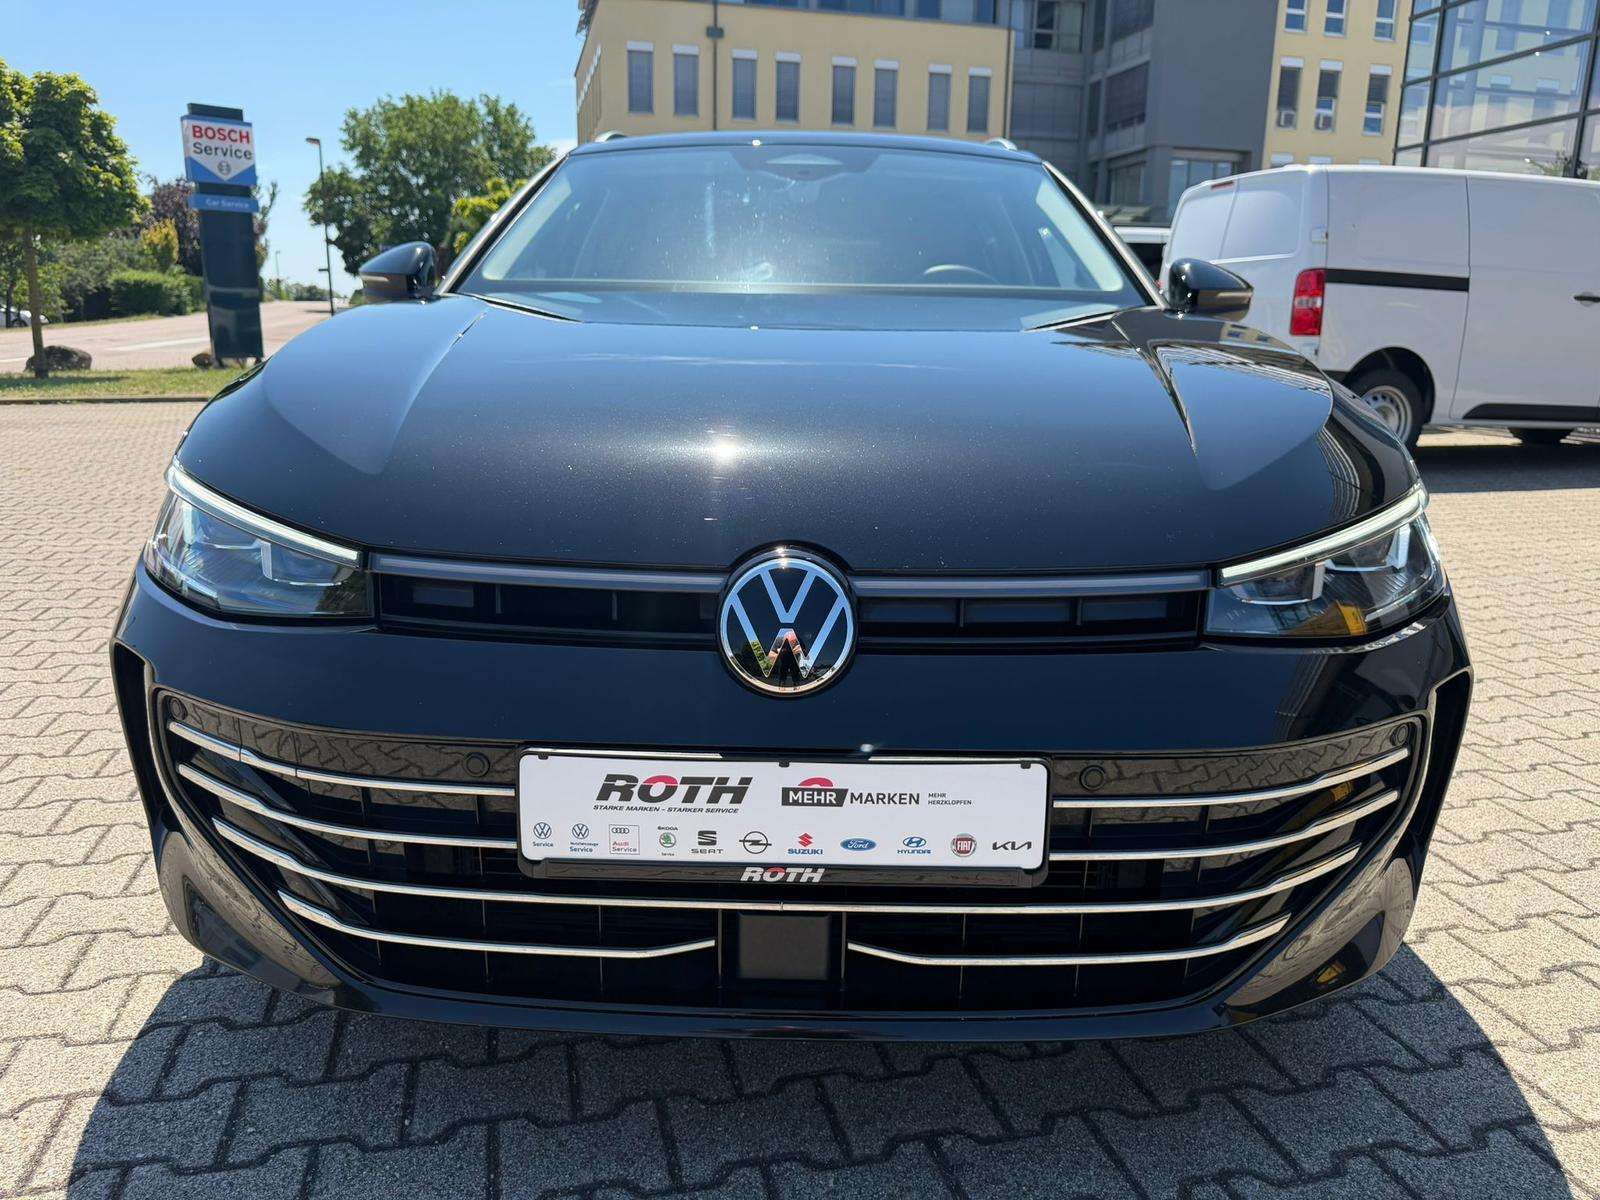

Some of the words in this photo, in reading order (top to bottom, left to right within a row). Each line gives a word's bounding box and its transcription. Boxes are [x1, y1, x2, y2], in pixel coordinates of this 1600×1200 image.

[192, 125, 250, 144] BOSCH
[193, 142, 252, 160] Service
[221, 200, 250, 208] Service
[596, 774, 753, 804] ROTH
[789, 791, 837, 805] MEHR
[850, 792, 920, 805] MARKEN
[847, 839, 870, 850] Ford
[956, 841, 972, 851] FIAT
[992, 841, 1032, 851] KIA
[740, 867, 825, 882] ROTH
